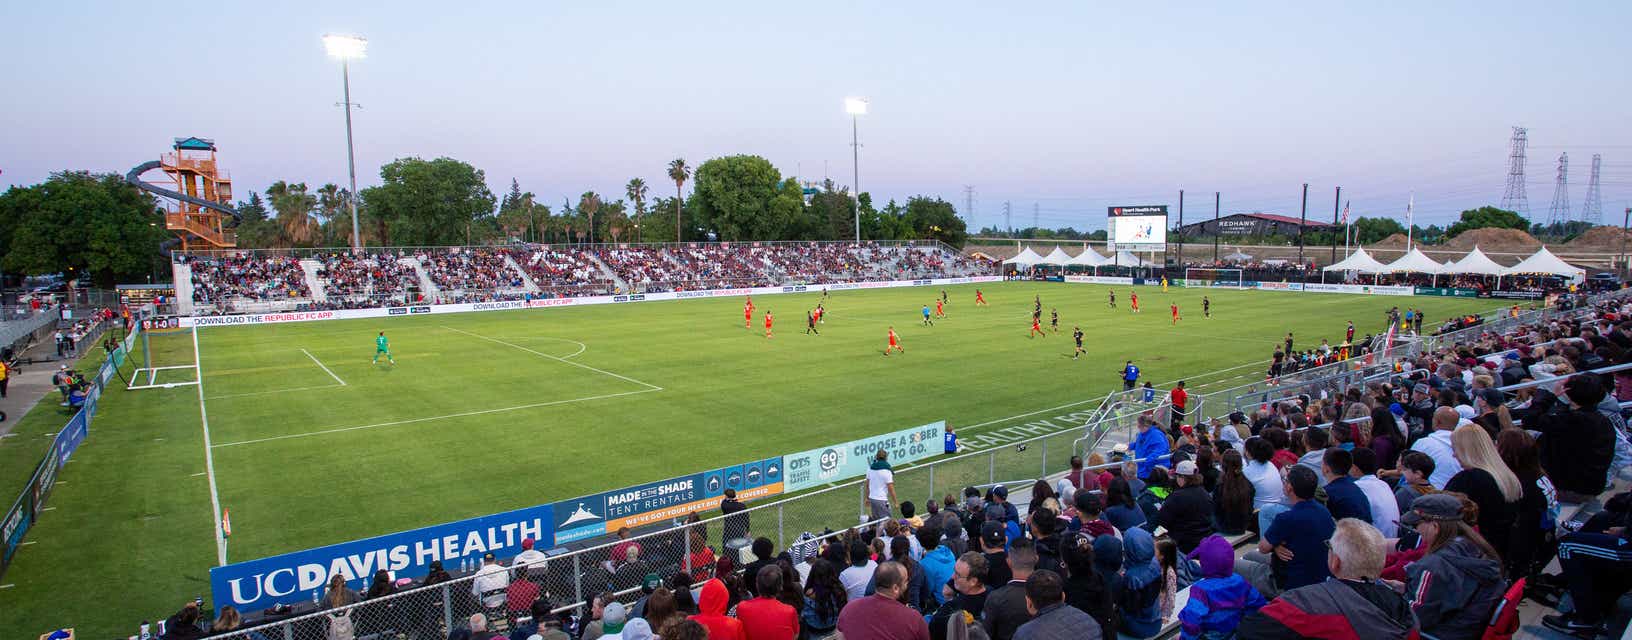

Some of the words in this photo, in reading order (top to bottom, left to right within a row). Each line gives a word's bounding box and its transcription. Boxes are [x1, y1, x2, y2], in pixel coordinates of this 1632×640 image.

[154, 320, 167, 328] 1-0
[194, 316, 244, 325] DOWNLOAD
[265, 313, 304, 321] REPUBLIC
[854, 438, 896, 456] CHOOSE
[899, 435, 906, 446] A
[893, 448, 906, 460] TO
[909, 444, 926, 456] GO.
[822, 452, 837, 463] GO
[608, 490, 641, 506] MADE
[658, 480, 693, 495] SHADE
[609, 503, 639, 516] TENT
[645, 491, 694, 509] RENTALS
[625, 514, 649, 526] WE'VE
[667, 507, 686, 516] YOUR
[688, 502, 706, 511] NEXT
[415, 518, 542, 566] HEALTH
